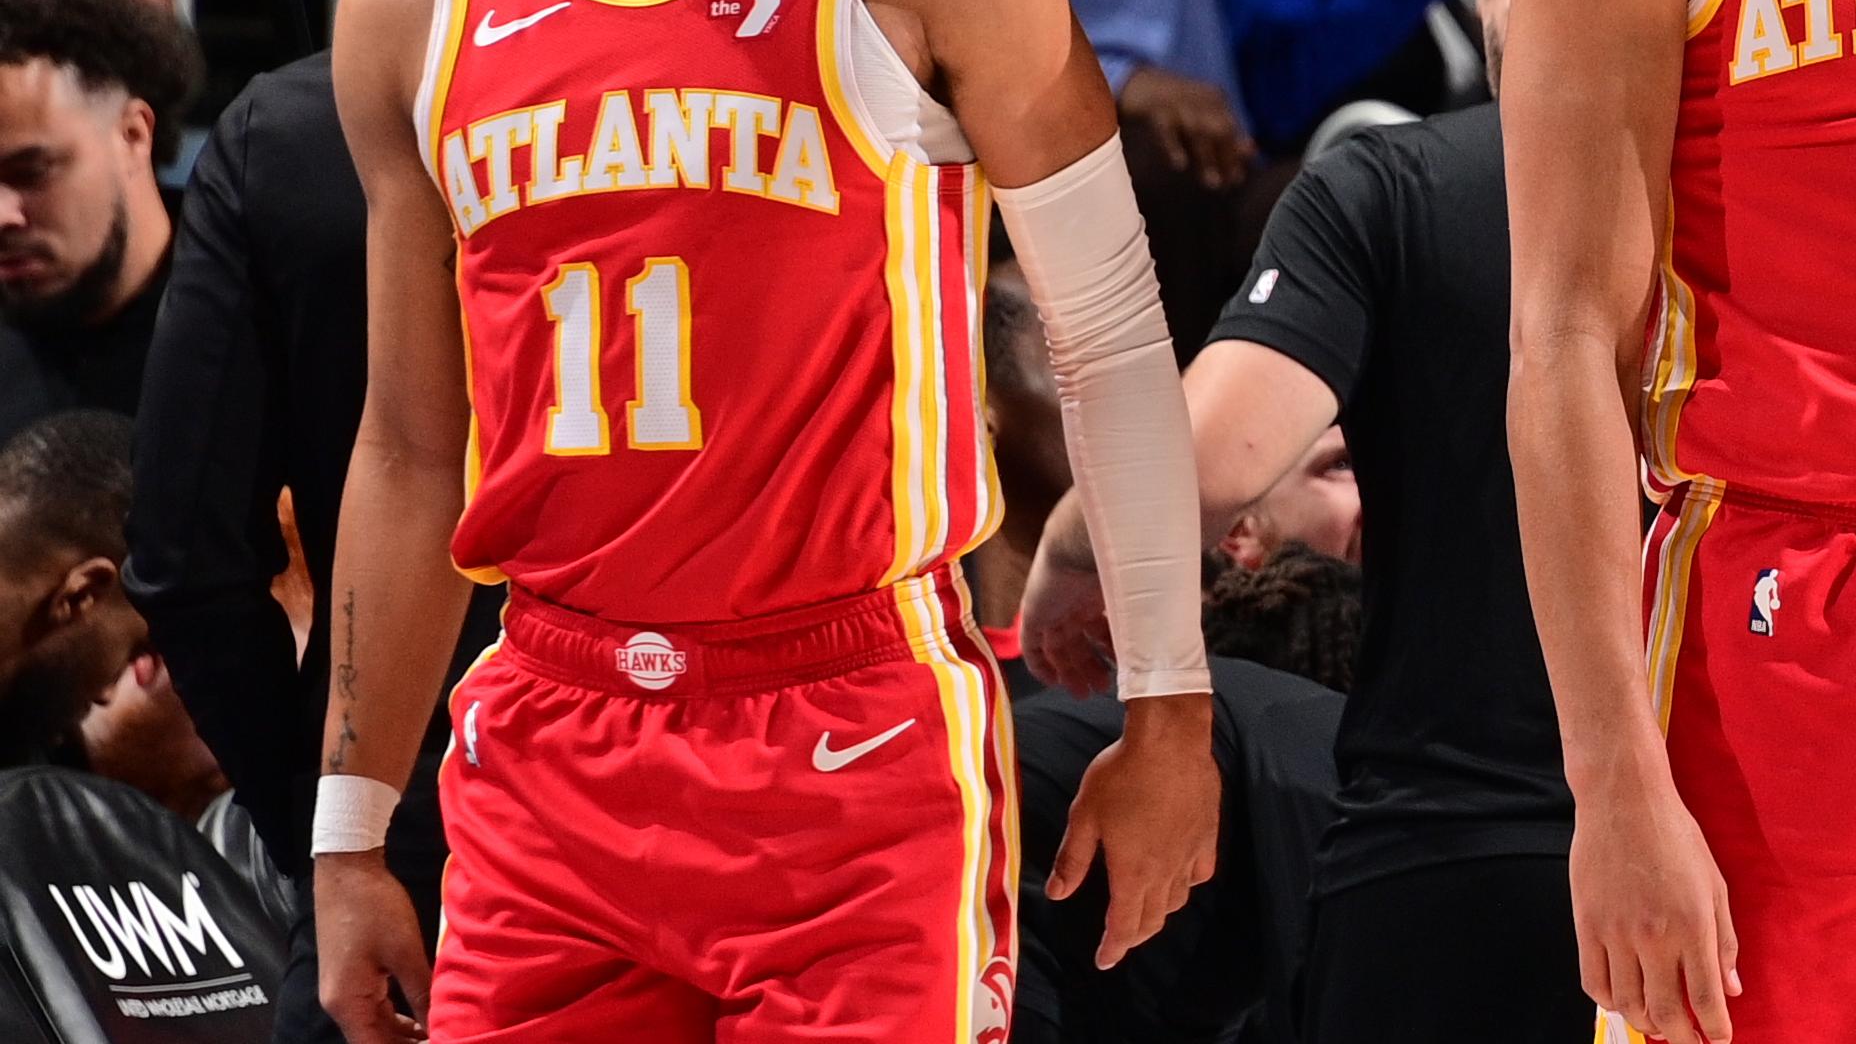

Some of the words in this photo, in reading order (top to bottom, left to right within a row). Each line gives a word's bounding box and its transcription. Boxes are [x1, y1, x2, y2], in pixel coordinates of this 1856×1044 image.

[710, 0, 741, 17] the
[442, 88, 840, 240] ATLANTA
[539, 256, 703, 456] 11
[618, 650, 685, 673] HAWKS
[48, 873, 245, 980] UWM
